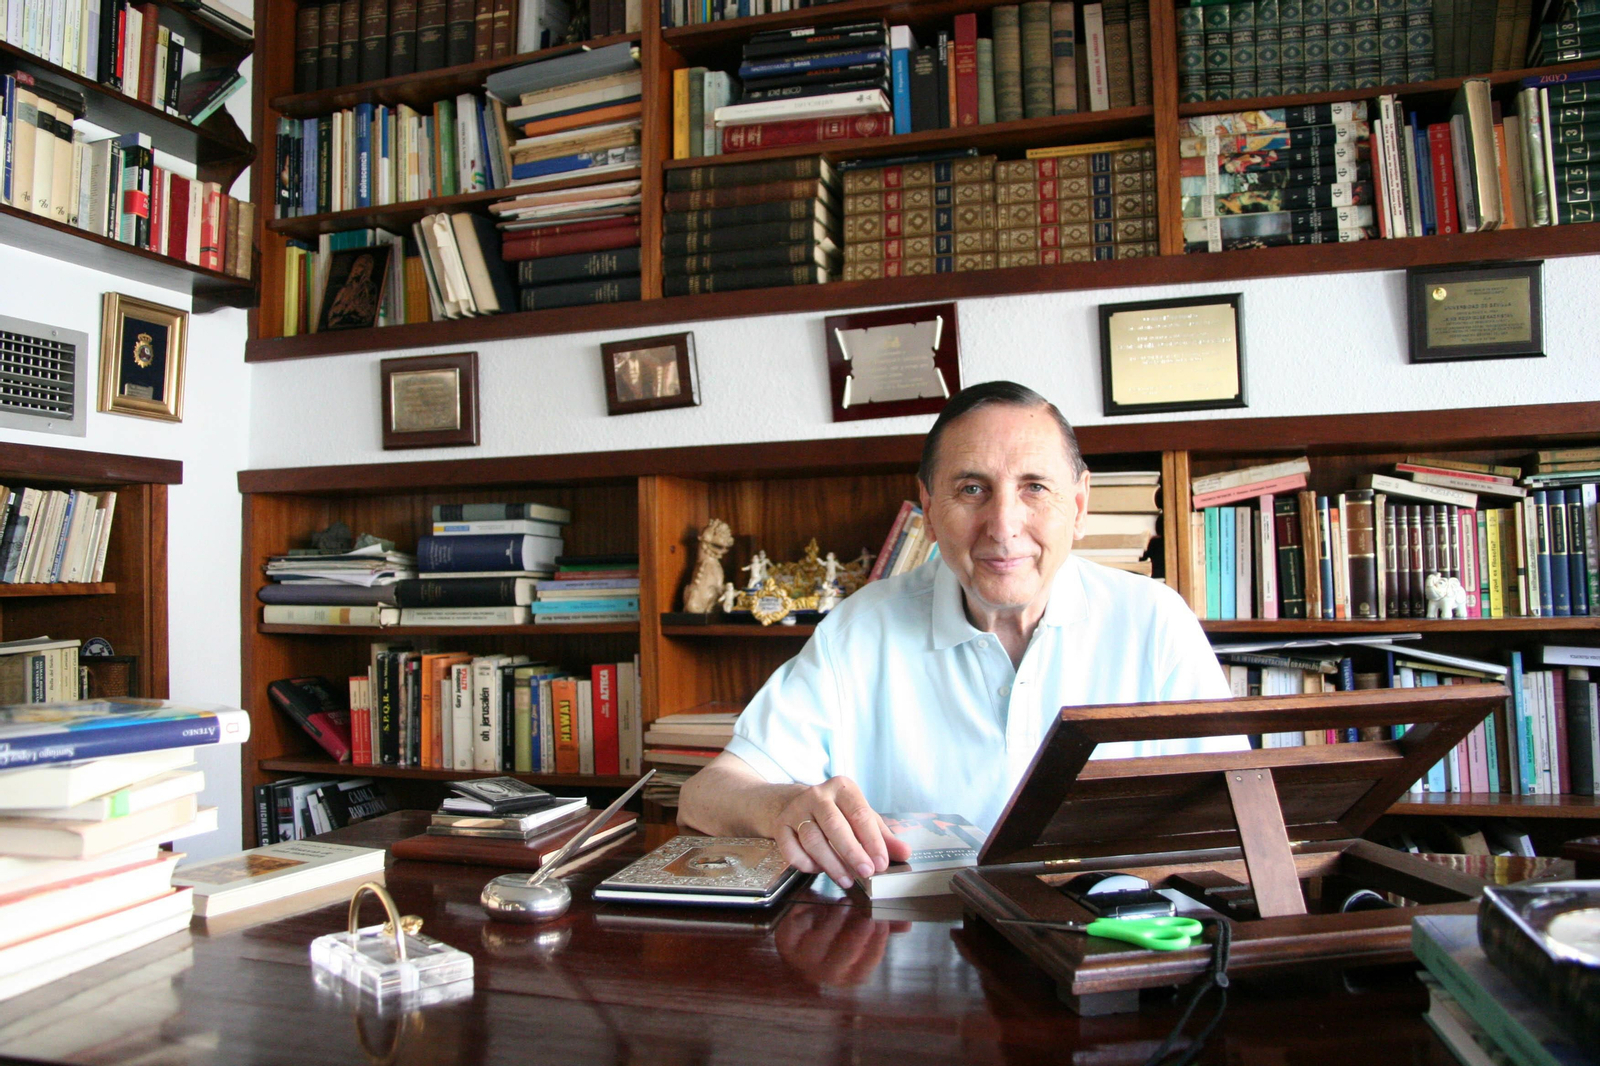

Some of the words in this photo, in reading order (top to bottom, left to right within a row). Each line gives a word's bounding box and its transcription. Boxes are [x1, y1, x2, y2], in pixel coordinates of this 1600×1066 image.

[1571, 187, 1585, 195] 6
[600, 669, 609, 700] AZTECA
[480, 687, 491, 727] jerusalén
[559, 700, 571, 742] HAWAI
[182, 726, 216, 737] ATENEO
[39, 746, 74, 758] Santiago
[260, 802, 269, 836] MICHAEL
